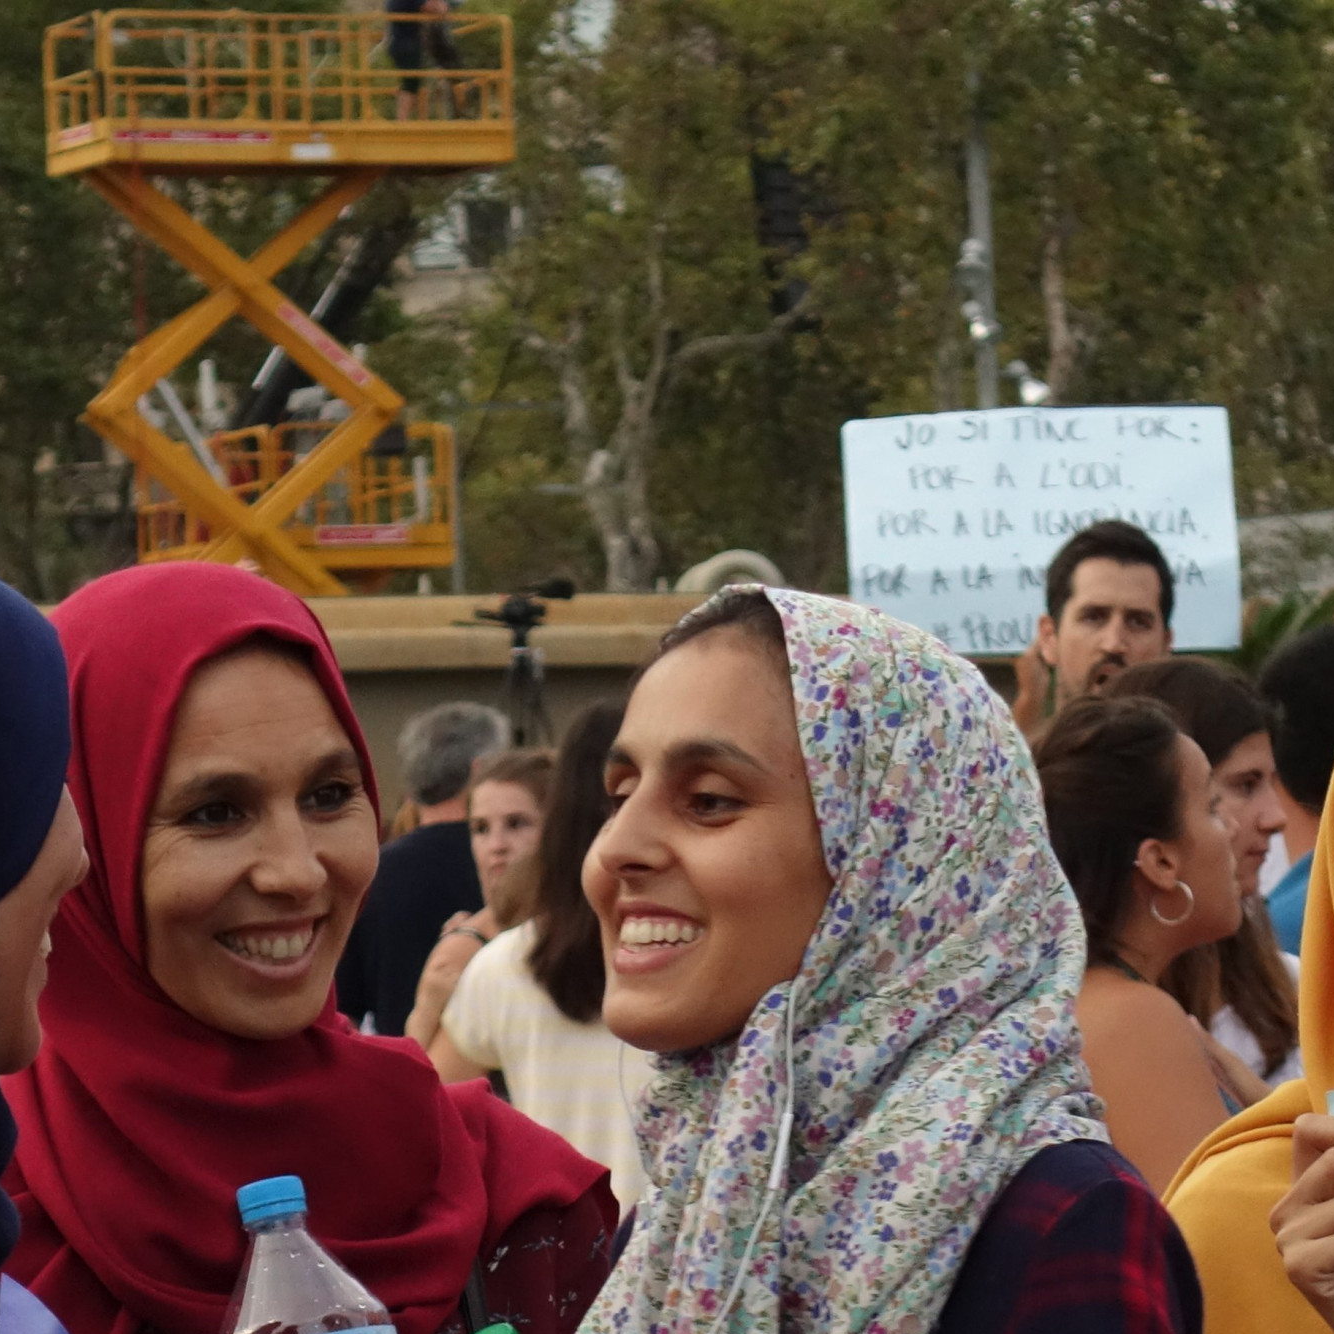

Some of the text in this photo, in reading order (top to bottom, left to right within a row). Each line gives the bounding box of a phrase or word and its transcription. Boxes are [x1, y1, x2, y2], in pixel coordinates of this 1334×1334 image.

[895, 420, 936, 450] JO
[908, 464, 975, 490] POR
[995, 461, 1016, 488] A
[877, 510, 938, 537] POR
[954, 510, 970, 536] A
[982, 509, 1014, 538] LA
[931, 567, 949, 595] A
[963, 562, 994, 590] LA
